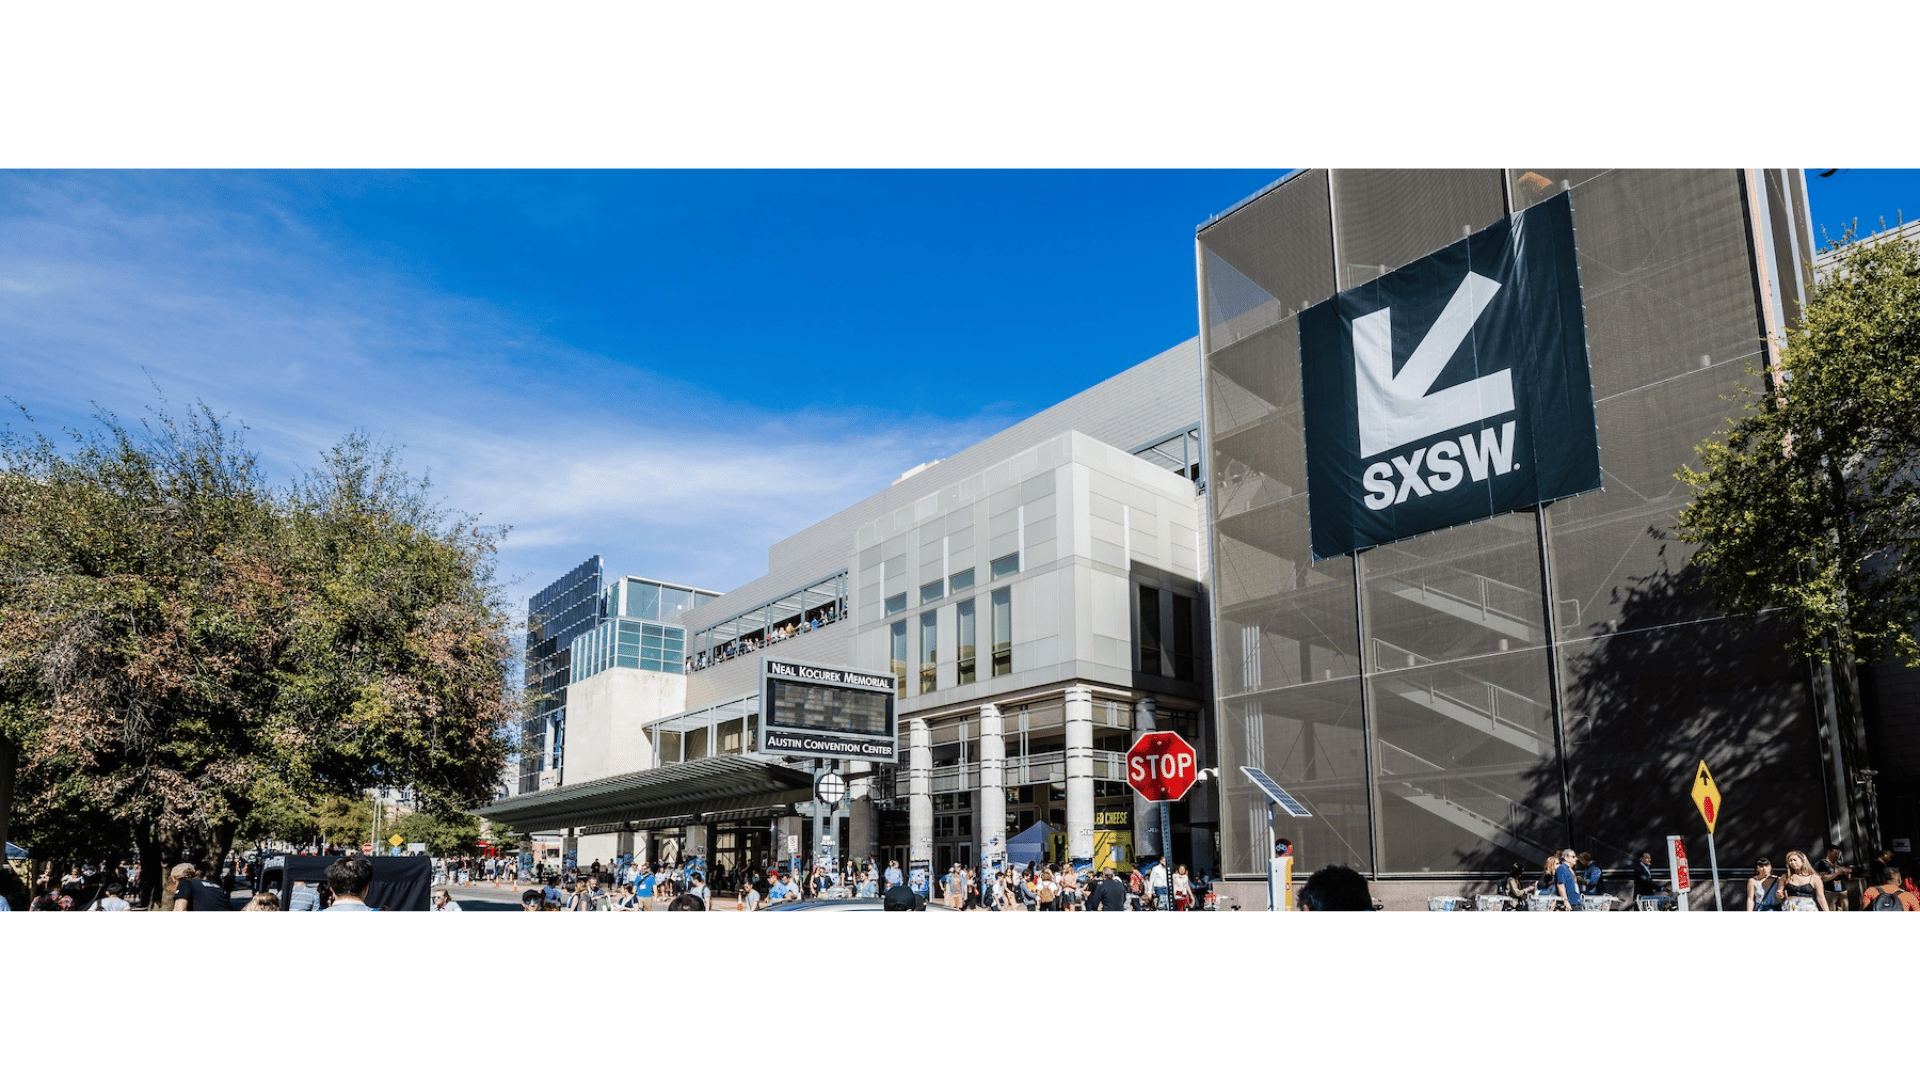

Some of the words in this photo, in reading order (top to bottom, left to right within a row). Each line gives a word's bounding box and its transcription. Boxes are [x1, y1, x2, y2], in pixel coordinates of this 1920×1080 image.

[1362, 420, 1521, 511] SXSW.
[772, 663, 796, 676] NEAL
[799, 666, 840, 682] KOCUREK
[843, 673, 889, 688] MEMORIAL
[767, 736, 801, 748] AUSTIN
[803, 739, 860, 752] CONVENTION
[862, 744, 892, 755] CENTER
[1131, 752, 1192, 782] STOP
[1105, 811, 1128, 825] CHEESE
